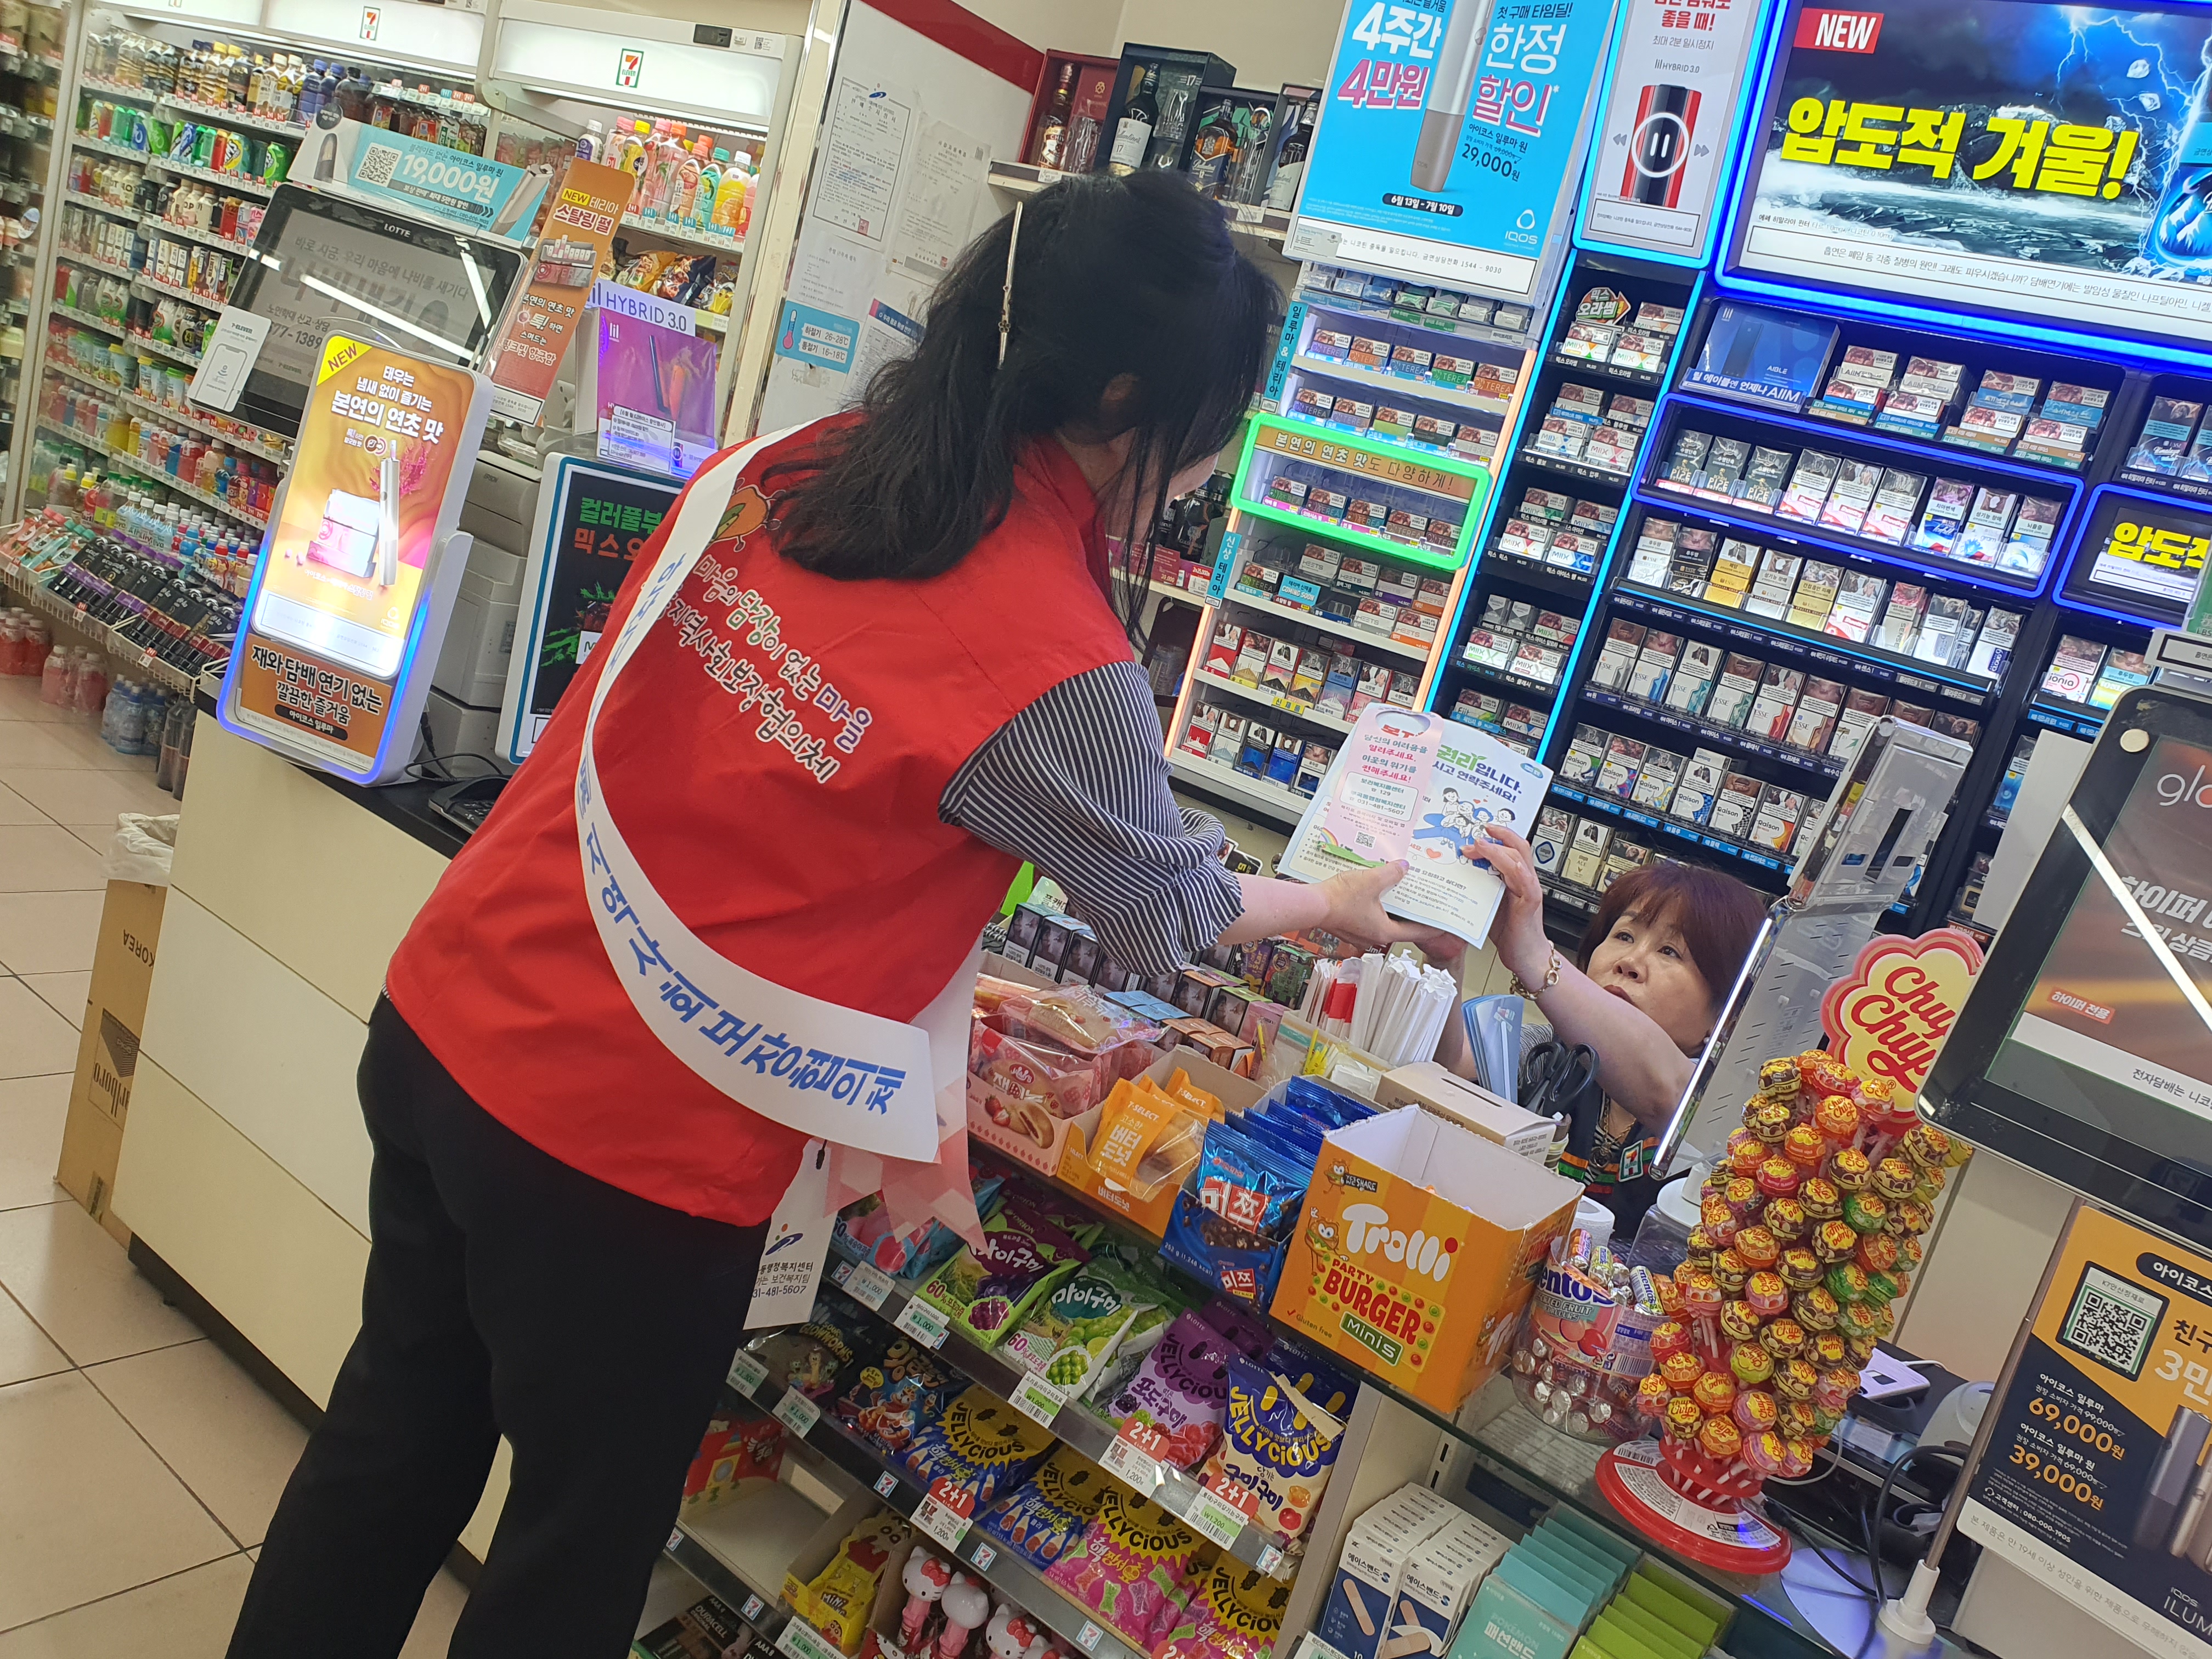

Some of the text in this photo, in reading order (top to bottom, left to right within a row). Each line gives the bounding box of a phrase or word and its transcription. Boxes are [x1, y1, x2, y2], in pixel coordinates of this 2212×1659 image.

[1497, 3, 1573, 20] 첫 구매 타임딜!
[1662, 10, 1716, 31] 좋을 때!
[1352, 2, 1442, 59] 4주간
[1652, 35, 1714, 50] 최대 일시정지
[1815, 14, 1876, 50] NEW
[1485, 22, 1567, 75] 한정
[1663, 63, 1700, 74] HYBRID 3.0
[1336, 59, 1430, 110] 4만원
[1472, 74, 1552, 139] 할인
[449, 155, 474, 167] 아이코스
[1462, 143, 1520, 181] 29,000원
[1780, 97, 2138, 200] 압도적 겨울!
[403, 154, 500, 204] 19,000원
[563, 189, 620, 216] NEW 테리아
[1404, 196, 1455, 215] 13일 7월 10일
[383, 223, 412, 238] LOTTE
[552, 204, 597, 232] 스탈링
[1505, 230, 1538, 245] IQOS
[295, 236, 400, 275] 바로 마음에
[1824, 246, 1847, 258] 흡연은
[1848, 250, 1864, 262] 폐암
[1865, 252, 1875, 263] 등
[1876, 254, 1891, 266] 각종
[1894, 257, 1917, 269] 질병의
[1938, 263, 1963, 275] 그래도
[1966, 268, 2028, 285] 피우시겠습니까?
[2030, 277, 2081, 292] 담배연기에는
[2084, 284, 2111, 298] 발암성
[2112, 289, 2140, 301] 물질인
[2192, 300, 2211, 313] 니켈
[1590, 290, 1610, 301] 믹스
[267, 303, 296, 320] 노인학대
[606, 292, 687, 332] HYBRID 3.0
[1577, 301, 1618, 319] 오라썸
[805, 325, 822, 338] 하절기
[326, 343, 358, 372] NEW
[802, 341, 819, 354] 동절기
[1268, 304, 1303, 398] 일루마 & 테리아
[1566, 341, 1584, 350] MIIX
[1617, 353, 1635, 363] MIIX
[383, 365, 415, 387] 태우는
[1401, 364, 1425, 375] TEREA
[1442, 373, 1467, 384] TEREA
[356, 376, 433, 412] 냄새 없이 즐기는
[1485, 382, 1511, 393] TEREA
[1740, 380, 1802, 403] 언제나 AIIM
[331, 390, 444, 444] 본연의 연초 맛
[1274, 432, 1317, 455] 본연의
[1321, 444, 1349, 464] 연초
[1387, 461, 1454, 489] 다양하게!
[1212, 535, 1235, 595] 신상 테리아
[1252, 579, 1273, 592] TEREA
[1282, 585, 1299, 597] COMING
[692, 554, 872, 754] 마음의 담장이 없는 마을
[1468, 645, 1485, 657] MIIX
[1516, 659, 1533, 670] MIIX
[1991, 654, 2001, 674] CLOUD
[251, 645, 383, 716] 재와 담배 연기 없는
[661, 591, 840, 785] 지역사회보장협의체
[276, 681, 351, 726] 깔끔한 즐거움
[1364, 734, 1428, 754] 당신의 어려움을
[1369, 744, 1416, 762] 알려주세요.
[1362, 754, 1417, 774] 이웃의 위기를
[1362, 765, 1412, 783] 전해주세요!
[1457, 770, 1517, 804] 연락주세요!
[1639, 780, 1661, 792] Raison
[1679, 793, 1701, 806] Raison
[1357, 799, 1404, 815] 031-481-5607
[1717, 805, 1740, 818] Raison
[1757, 820, 1780, 833] Raison
[2119, 874, 2207, 923] 하이퍼
[2050, 990, 2112, 1020] 하이퍼 전용
[2132, 1067, 2185, 1097] 전자담배는
[1126, 1100, 1160, 1123] 7-SELECT
[1110, 1124, 1143, 1148] 버터
[1099, 1141, 1137, 1168] 도넛
[1097, 1184, 1130, 1212] 버터도넛
[1356, 1178, 1376, 1192] SHARE
[1199, 1175, 1270, 1233] 미쯔
[1342, 1203, 1459, 1282] Trolli
[771, 1274, 811, 1284] 보건복지팀
[1332, 1258, 1375, 1285] PARTY
[926, 1279, 947, 1304] 60%
[1051, 1281, 1122, 1316] 마이구미
[1322, 1272, 1421, 1345] BURGER
[1562, 1301, 1593, 1315] FRUIT
[1296, 1313, 1333, 1340] Gluten free
[2040, 1373, 2104, 1414] 아이코스 일루마
[2049, 1392, 2069, 1407] 소비자
[1129, 1421, 1162, 1451] 2+1
[2029, 1397, 2125, 1460] 69,000원
[2020, 1423, 2084, 1464] 아이코스 일루마
[2029, 1442, 2049, 1456] 소비자
[1222, 1462, 1284, 1511] 구미구미
[1257, 1466, 1275, 1481] 당기는
[2009, 1444, 2104, 1511] 39,000원
[939, 1481, 969, 1510] 2+1
[1215, 1477, 1250, 1509] 2+1
[1995, 1493, 2072, 1543] 고객센터 080-000-1905
[1970, 1514, 2083, 1590] 본 제품은 만 이상 성인을
[1347, 1552, 1391, 1584] 에이스밴드-S
[1406, 1573, 1451, 1607] 에이스밴드-S
[2170, 1587, 2200, 1607] IQOS
[695, 1605, 728, 1639] DURACELL
[1484, 1621, 1536, 1659] 패션밴드
